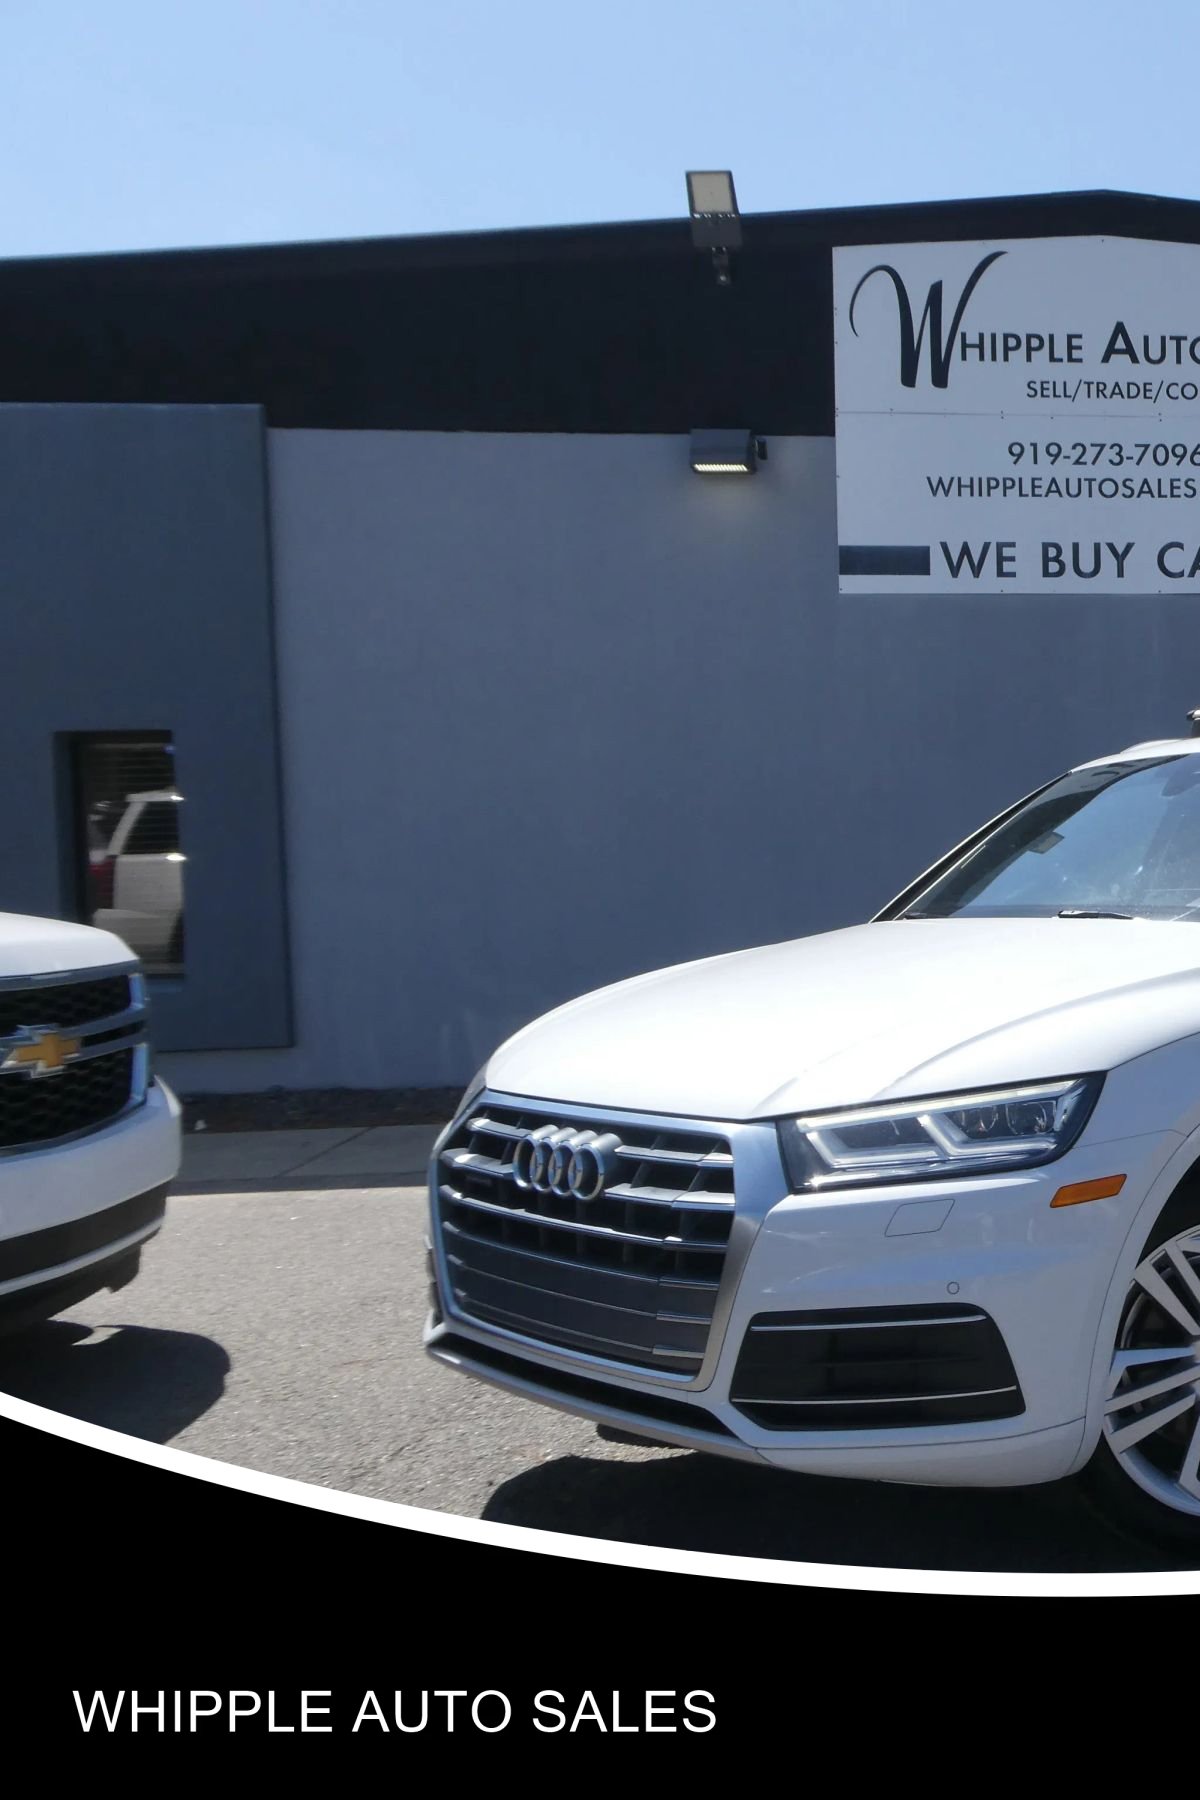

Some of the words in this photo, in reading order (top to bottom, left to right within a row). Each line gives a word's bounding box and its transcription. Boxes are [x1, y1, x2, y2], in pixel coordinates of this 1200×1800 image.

[849, 250, 1084, 389] WHIPPLE
[939, 541, 1017, 579] WE
[1041, 541, 1136, 579] BUY
